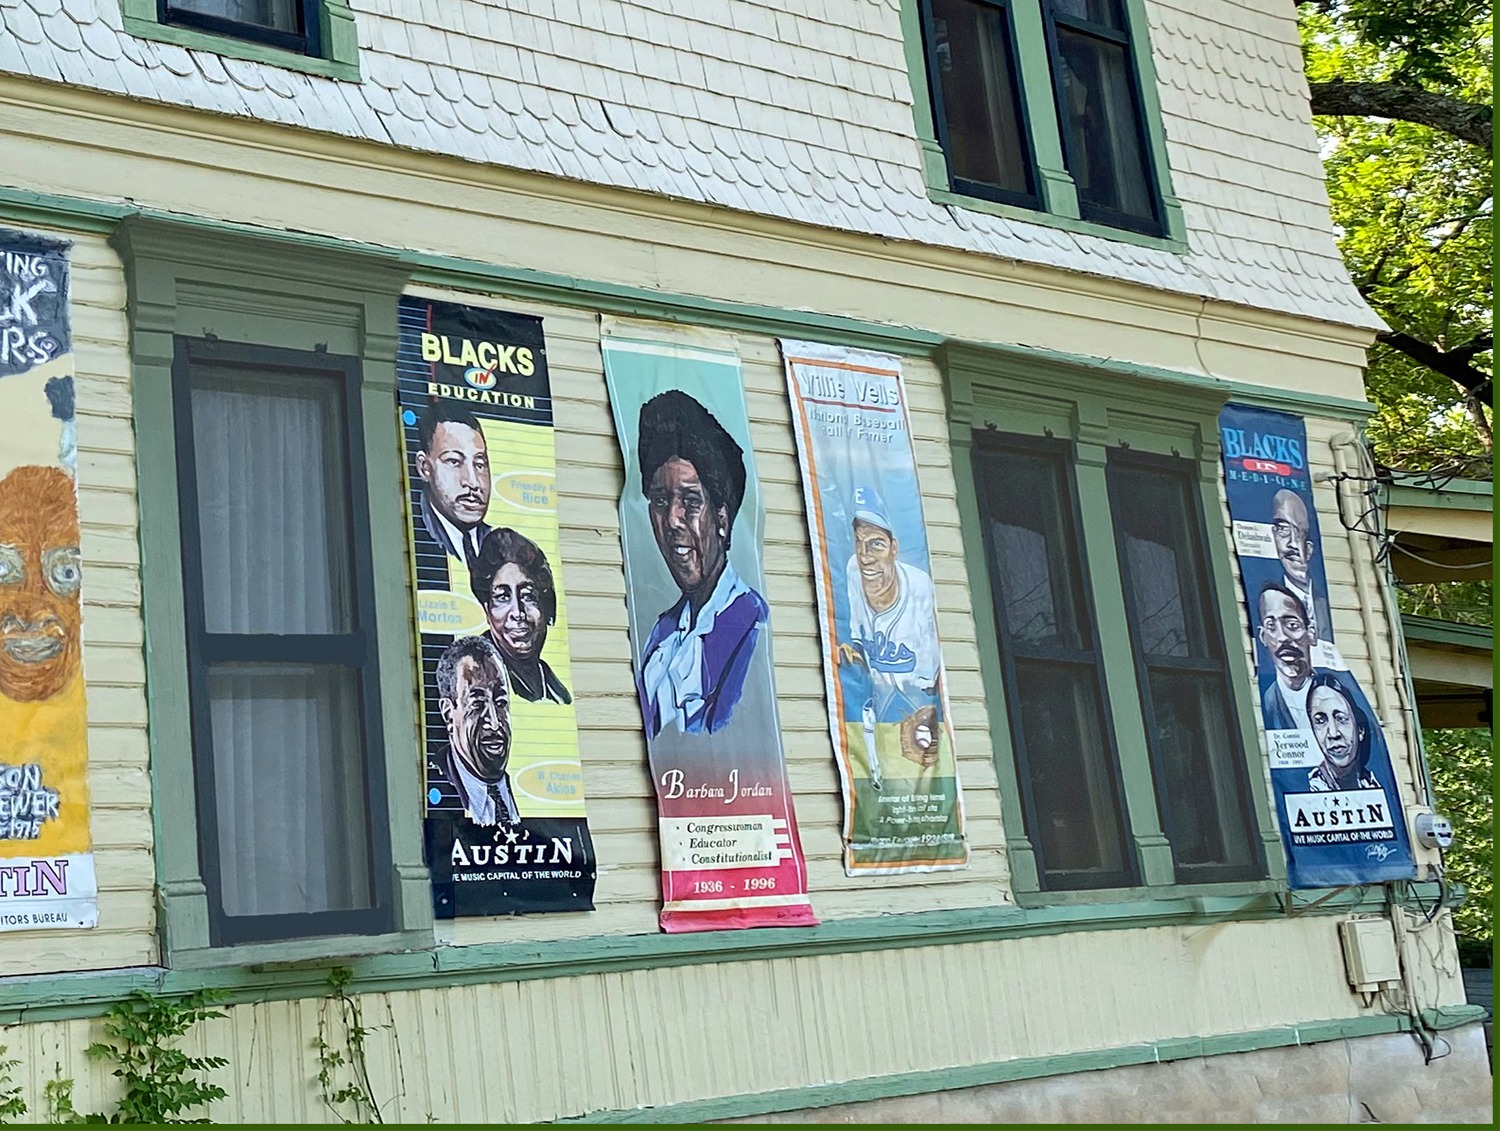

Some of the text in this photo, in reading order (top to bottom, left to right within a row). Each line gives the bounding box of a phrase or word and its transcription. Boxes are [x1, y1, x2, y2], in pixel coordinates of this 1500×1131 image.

[421, 332, 535, 377] BLACKS
[475, 367, 493, 385] IN
[428, 382, 535, 409] EDUCATION
[1222, 427, 1303, 470] BLACKS
[1256, 462, 1278, 470] IN
[522, 492, 548, 505] Rice
[855, 488, 865, 504] E
[418, 612, 462, 624] Morton
[1274, 740, 1309, 750] Yerwood
[661, 769, 773, 804] Barbara Jordan
[1294, 803, 1385, 828] AUSTIN
[687, 822, 763, 835] Congresswoman
[689, 838, 737, 849] Educator
[1306, 833, 1326, 844] MUSIC
[1326, 832, 1350, 843] CAPITAL
[1371, 830, 1394, 839] WORLD
[452, 837, 572, 866] AUSTIN
[691, 851, 772, 864] Constitutionalist
[461, 872, 486, 881] MUSIC
[487, 871, 520, 881] CAPITAL
[535, 871, 550, 879] THE
[551, 870, 582, 879] WORLD
[693, 880, 723, 894] 1936
[743, 877, 776, 891] 1996
[32, 912, 68, 924] BUREAU
